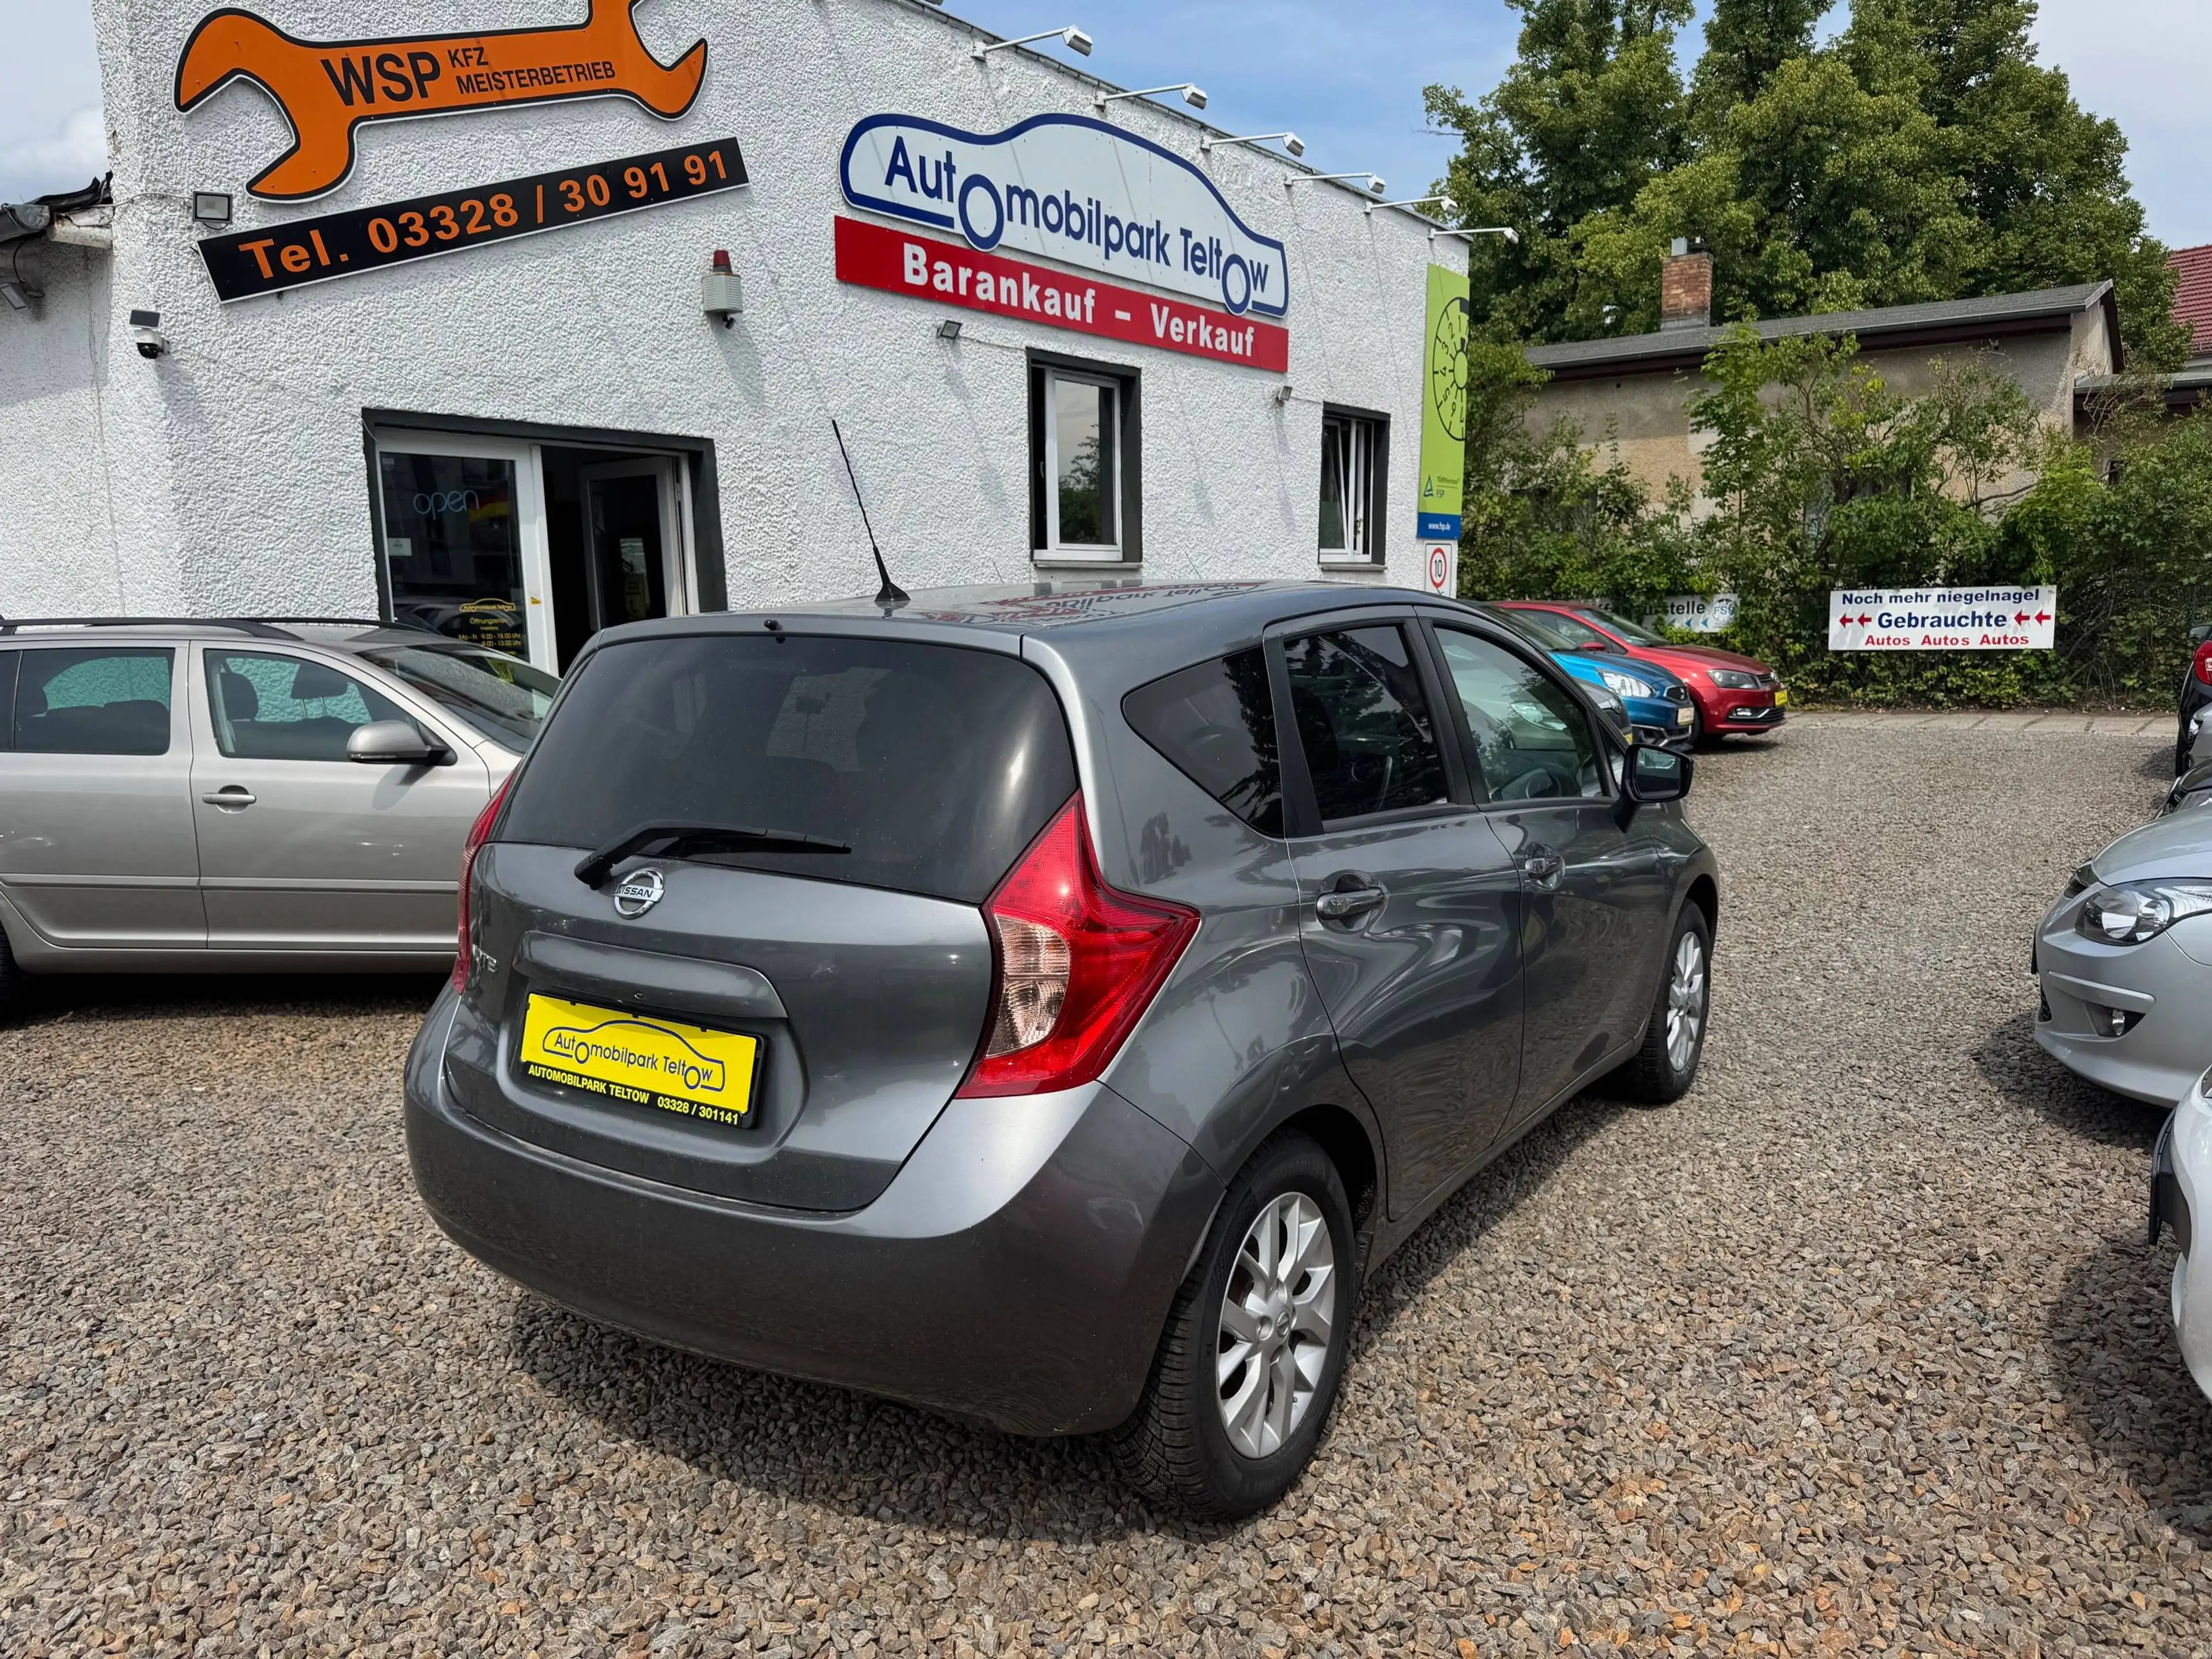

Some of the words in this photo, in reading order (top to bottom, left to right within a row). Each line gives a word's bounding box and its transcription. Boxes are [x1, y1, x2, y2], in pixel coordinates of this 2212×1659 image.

[447, 47, 489, 68] KFZ
[320, 52, 441, 107] WSP
[456, 61, 616, 94] MEISTERBETRIEB
[238, 230, 349, 279] Tel.
[368, 194, 519, 253] 03328
[536, 184, 544, 224] /
[559, 174, 611, 212] 30
[624, 162, 670, 198] 91
[683, 151, 728, 185] 91
[903, 242, 1097, 324] Barankauf
[1114, 309, 1131, 321] -
[1150, 303, 1256, 357] Verkauf
[413, 489, 480, 521] open
[1434, 559, 1444, 578] 10
[1842, 593, 1883, 604] Noch
[1889, 594, 1931, 604] mehr
[1937, 589, 2040, 605] niegelnagel
[1877, 611, 2008, 628] Gebrauchte
[1865, 635, 1911, 646] Autos
[1921, 635, 1970, 646] Autos
[1979, 634, 2029, 645] Autos
[616, 884, 654, 899] NISSAN
[528, 1065, 607, 1094] AUTOMOBILPARK
[609, 1084, 650, 1104] TELTOW
[657, 1096, 690, 1114] 03328
[691, 1103, 698, 1116] /
[699, 1106, 739, 1126] 301141
